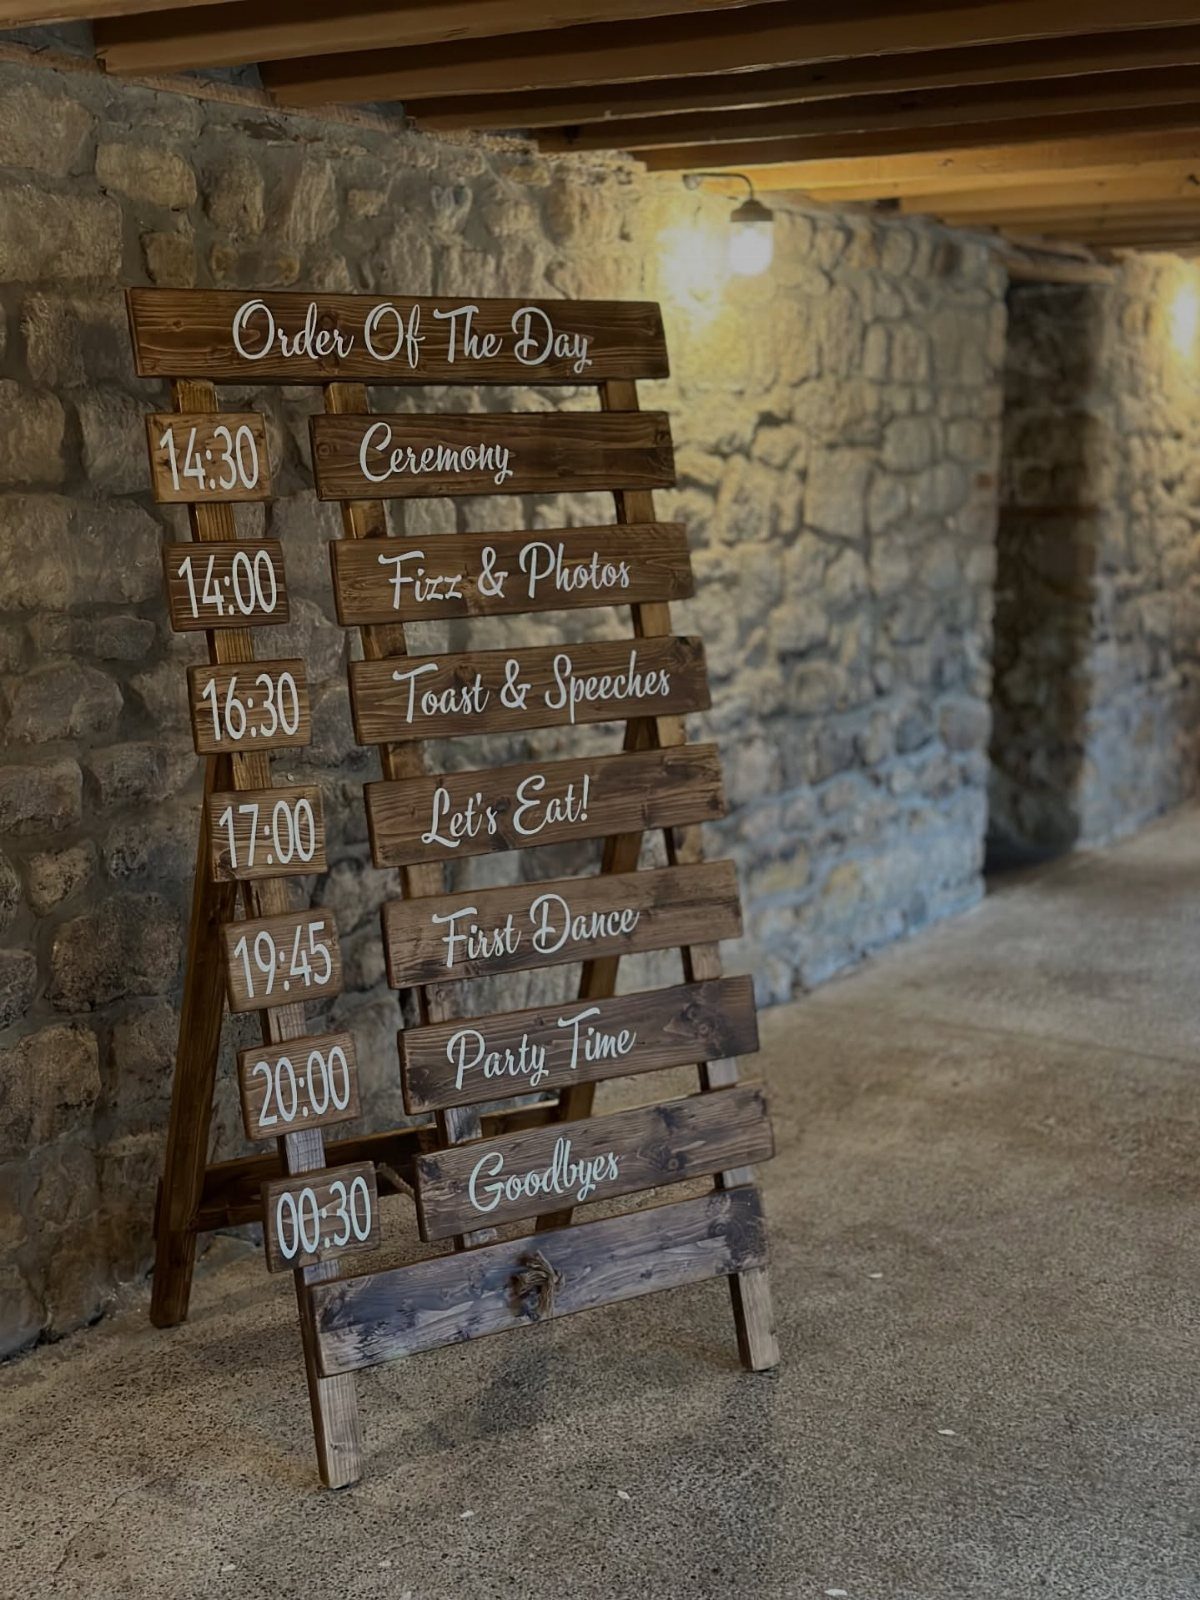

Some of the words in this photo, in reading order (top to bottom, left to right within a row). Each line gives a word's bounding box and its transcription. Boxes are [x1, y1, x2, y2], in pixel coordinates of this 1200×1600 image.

[232, 299, 355, 360] Order
[364, 302, 426, 369] Of
[433, 304, 503, 363] The
[511, 306, 593, 374] Day
[159, 425, 259, 491] 14:30
[359, 421, 514, 485] Ceremony
[177, 549, 277, 619] 14:00
[377, 550, 463, 610] Fizz
[477, 546, 509, 599] &
[518, 541, 630, 599] Photos
[201, 671, 300, 741] 16:30
[392, 662, 490, 724] Toast
[499, 658, 532, 710] &
[544, 649, 671, 724] Speeches
[218, 798, 316, 869] 17:00
[420, 787, 498, 849] Let's
[512, 774, 590, 836] Eat!
[233, 920, 332, 999] 19:45
[431, 906, 521, 968] First
[529, 893, 640, 955] Dance
[252, 1045, 350, 1127] 20:00
[446, 1029, 550, 1091] Party
[557, 1006, 637, 1070] Time
[468, 1137, 621, 1213] Goodbyes
[276, 1175, 372, 1260] 00:30
